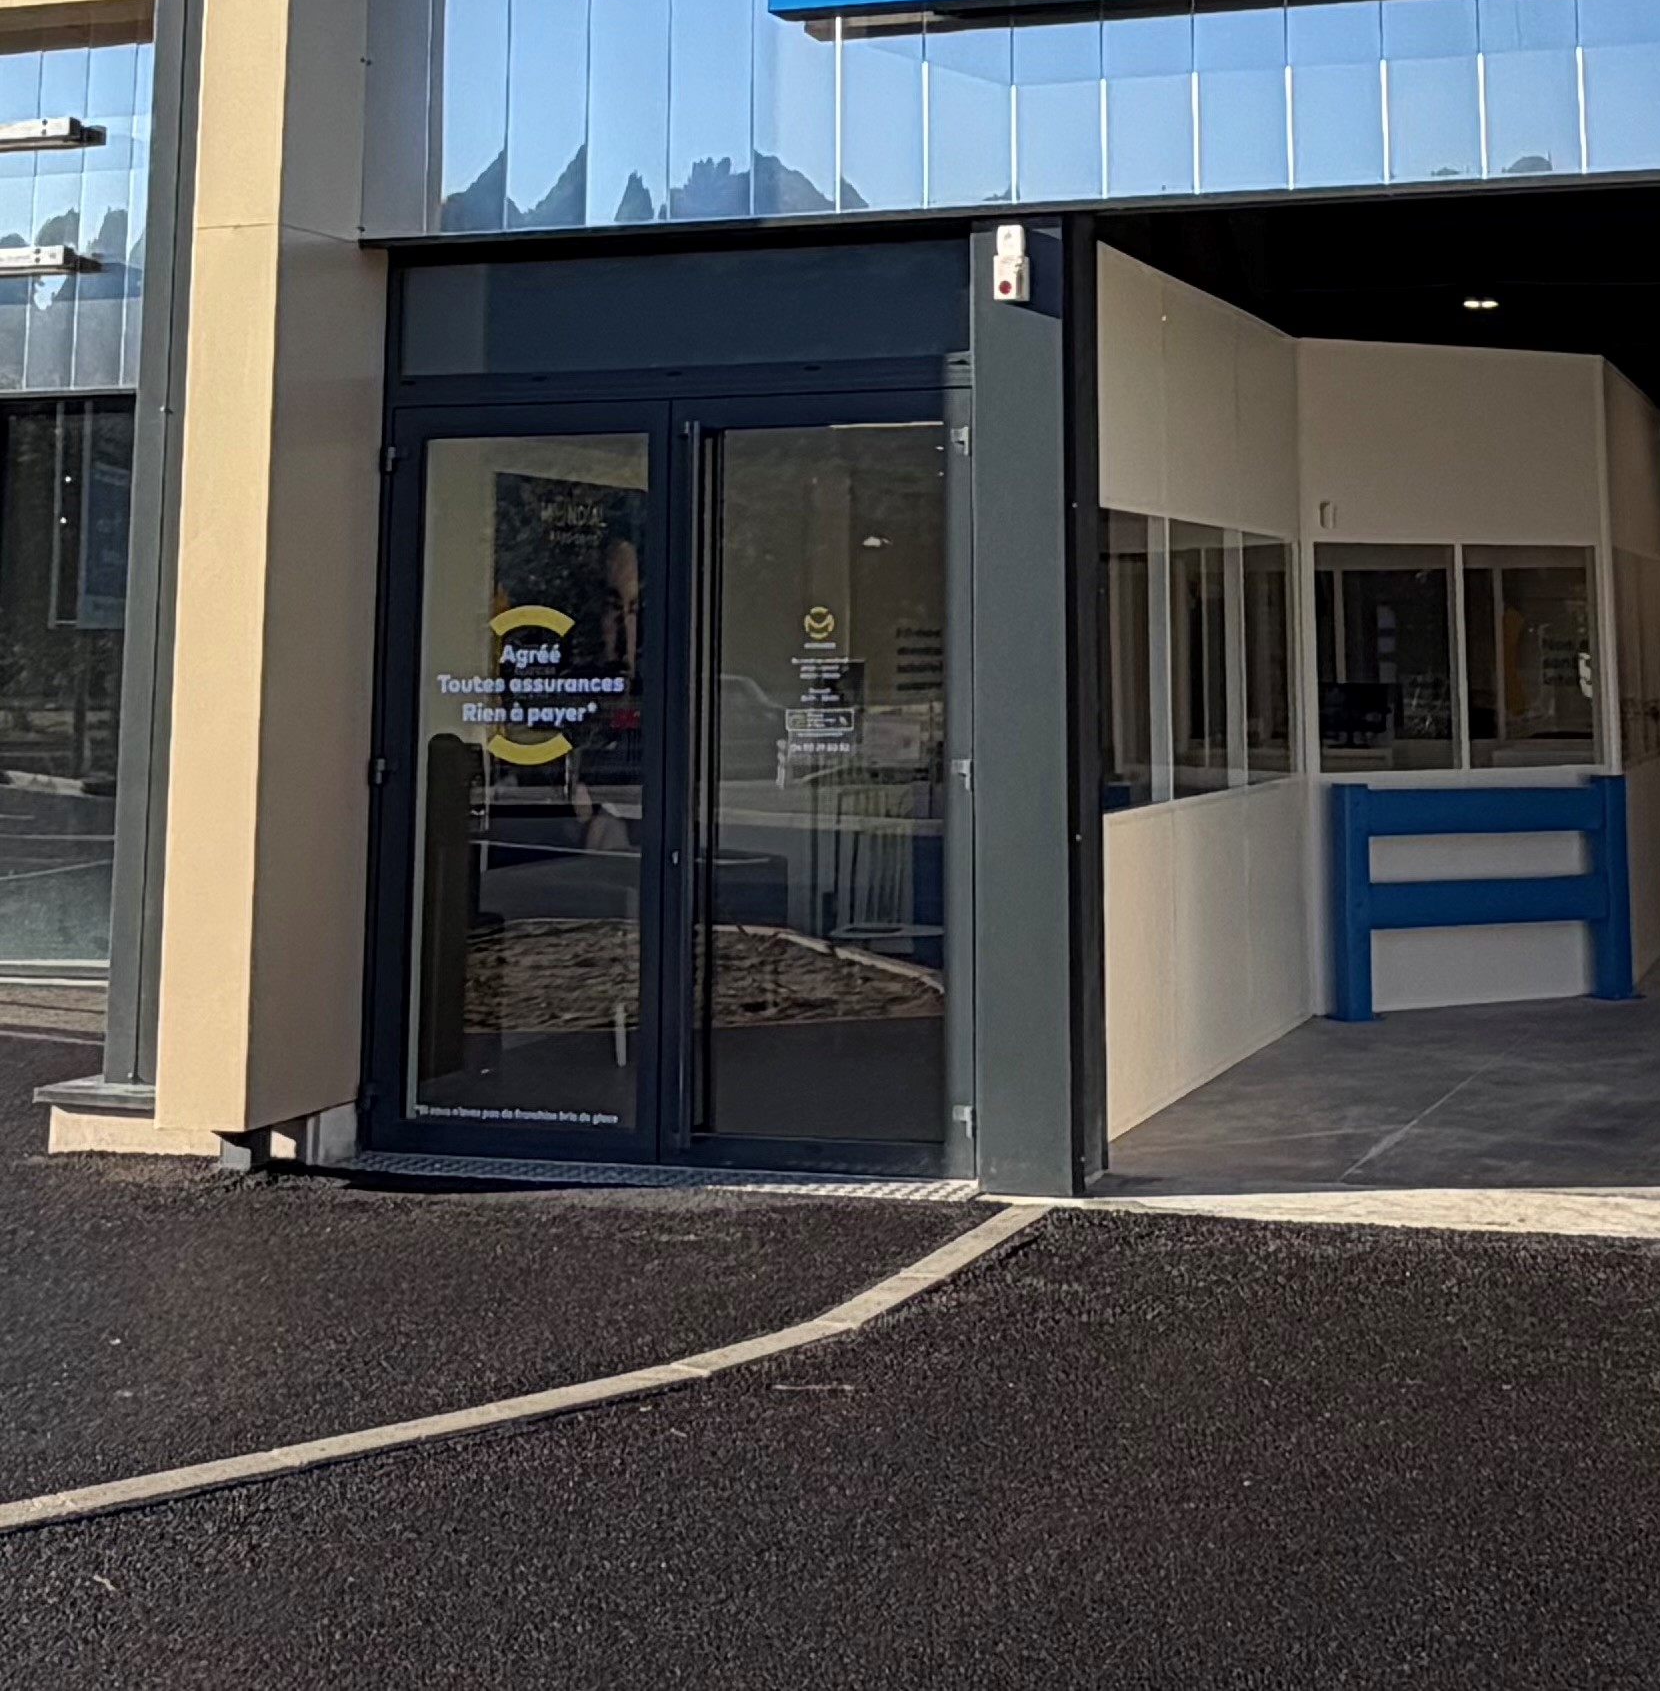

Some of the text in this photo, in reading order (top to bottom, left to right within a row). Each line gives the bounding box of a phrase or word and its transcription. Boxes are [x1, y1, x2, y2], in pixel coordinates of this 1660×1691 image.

[500, 643, 562, 668] Agréé
[437, 674, 625, 693] Toutes assurances
[462, 702, 506, 722] Rien
[510, 702, 523, 722] à
